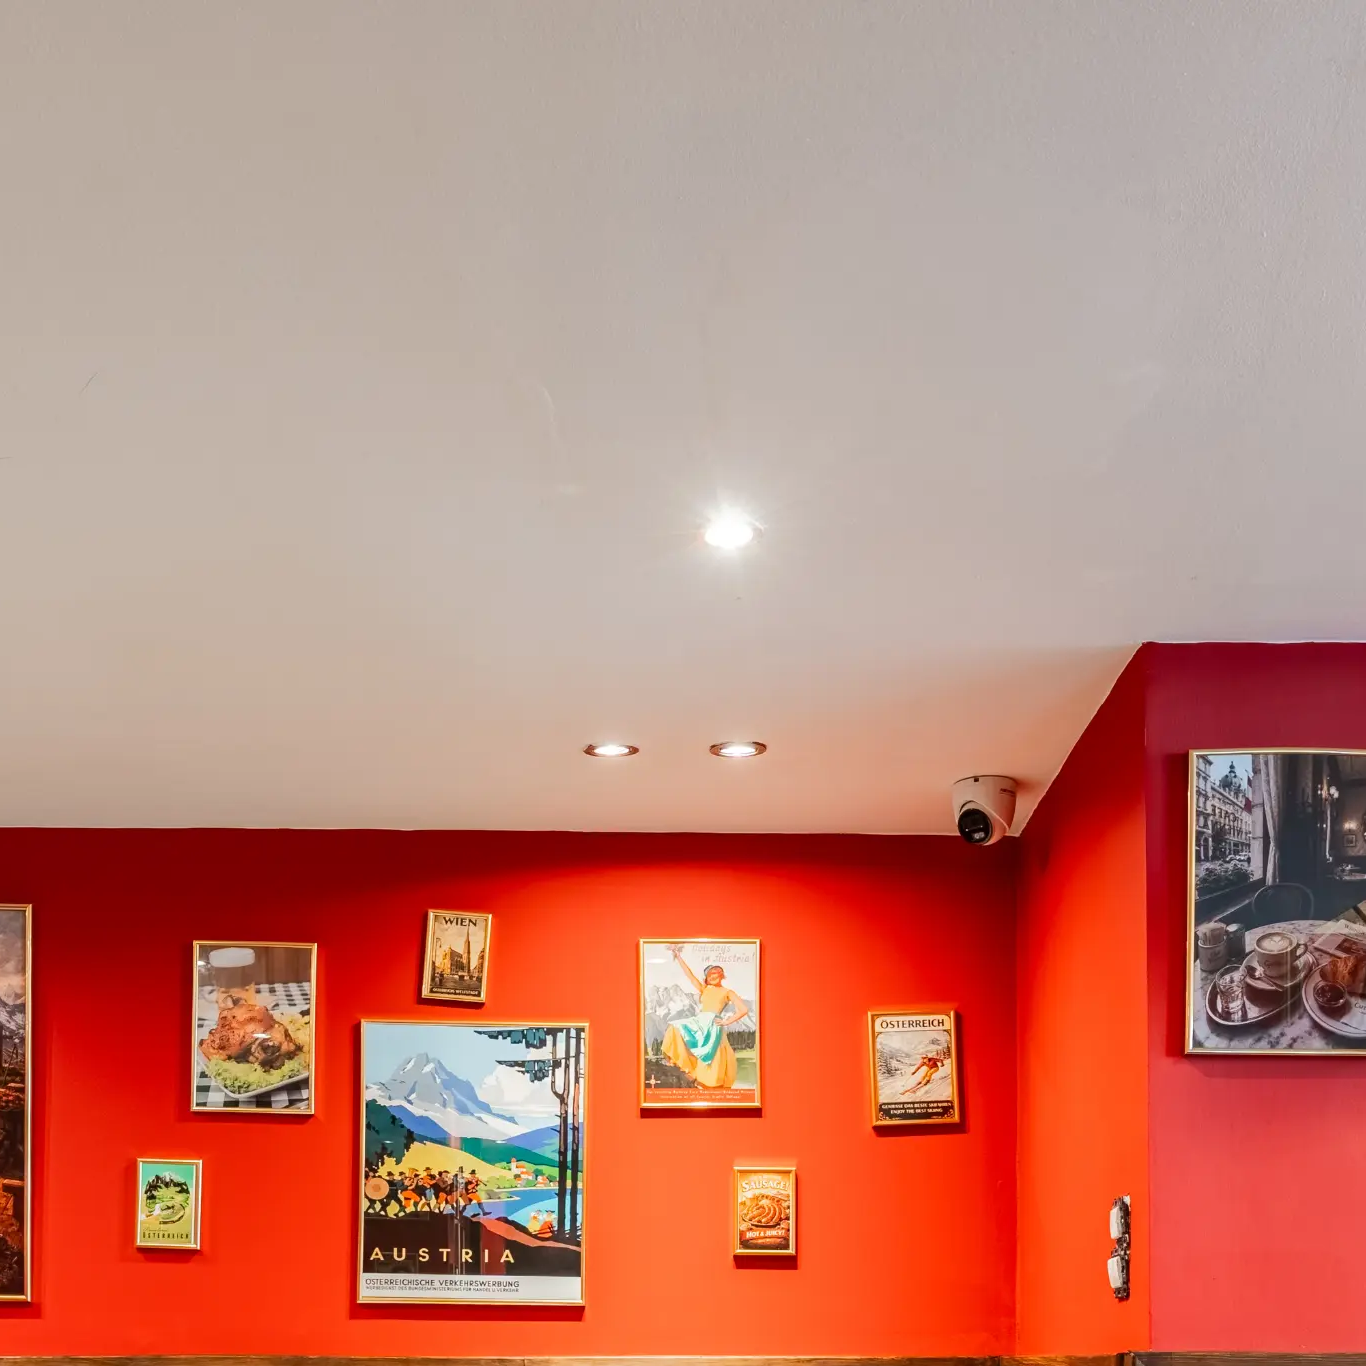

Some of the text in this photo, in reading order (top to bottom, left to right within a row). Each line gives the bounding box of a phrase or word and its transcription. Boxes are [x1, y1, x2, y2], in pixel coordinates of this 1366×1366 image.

[443, 916, 477, 928] WIEN
[880, 1018, 945, 1030] ÖSTERREICH
[741, 1180, 790, 1193] SAUSAGE!
[747, 1230, 760, 1239] HOT
[765, 1229, 786, 1238] JUICY!
[370, 1247, 515, 1264] AUSTRIA
[365, 1278, 520, 1288] ÖSTERREICHISCHE VERKEHRSWERBUNG
